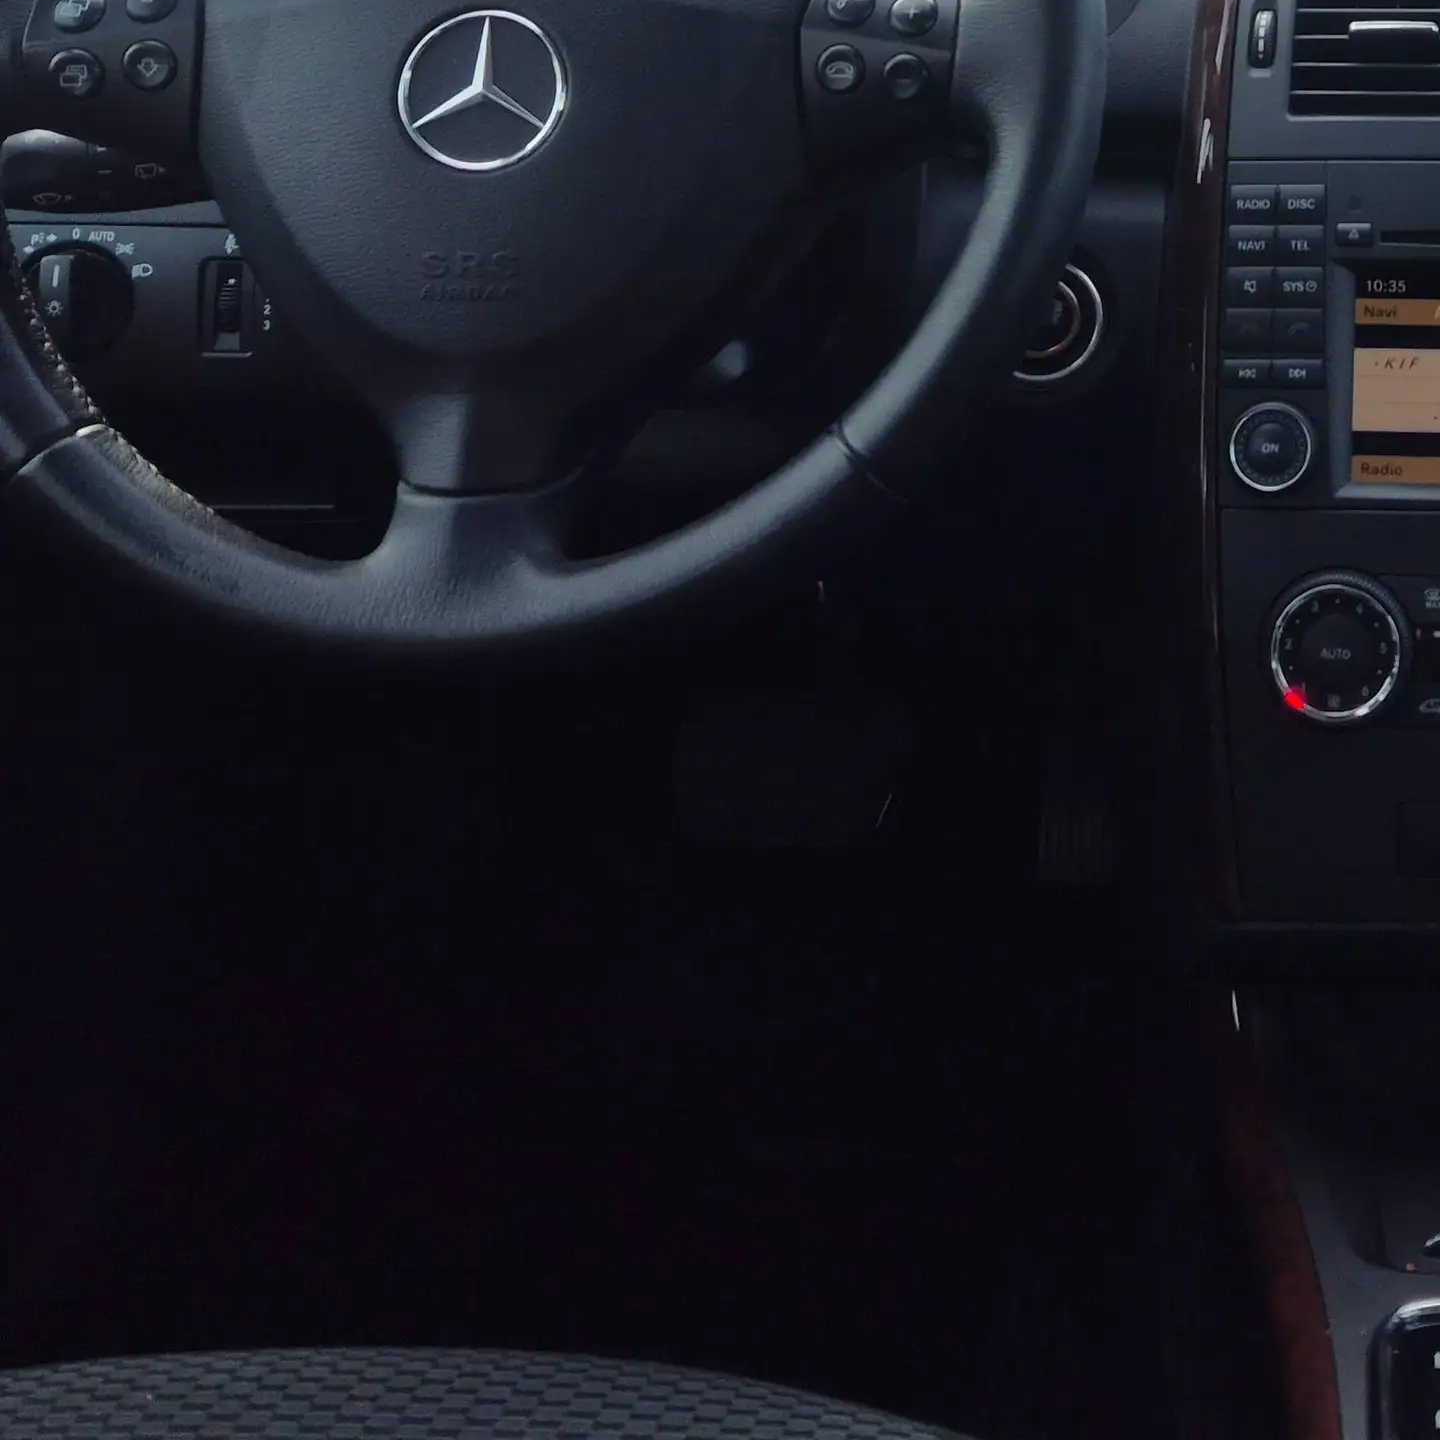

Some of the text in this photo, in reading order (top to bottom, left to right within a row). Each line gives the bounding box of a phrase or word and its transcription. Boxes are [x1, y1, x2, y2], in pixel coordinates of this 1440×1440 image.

[1236, 198, 1271, 210] RADIO
[1287, 198, 1316, 210] DISC
[88, 231, 115, 243] AUTO
[1237, 240, 1266, 251] NAVI
[1290, 239, 1310, 251] TEL
[421, 249, 519, 279] SRS
[1282, 280, 1305, 292] SYS
[1366, 279, 1407, 293] 10:35
[1364, 305, 1397, 318] Navi
[1261, 442, 1280, 454] ON
[1360, 461, 1403, 477] Radio
[1320, 647, 1351, 660] AUTO
